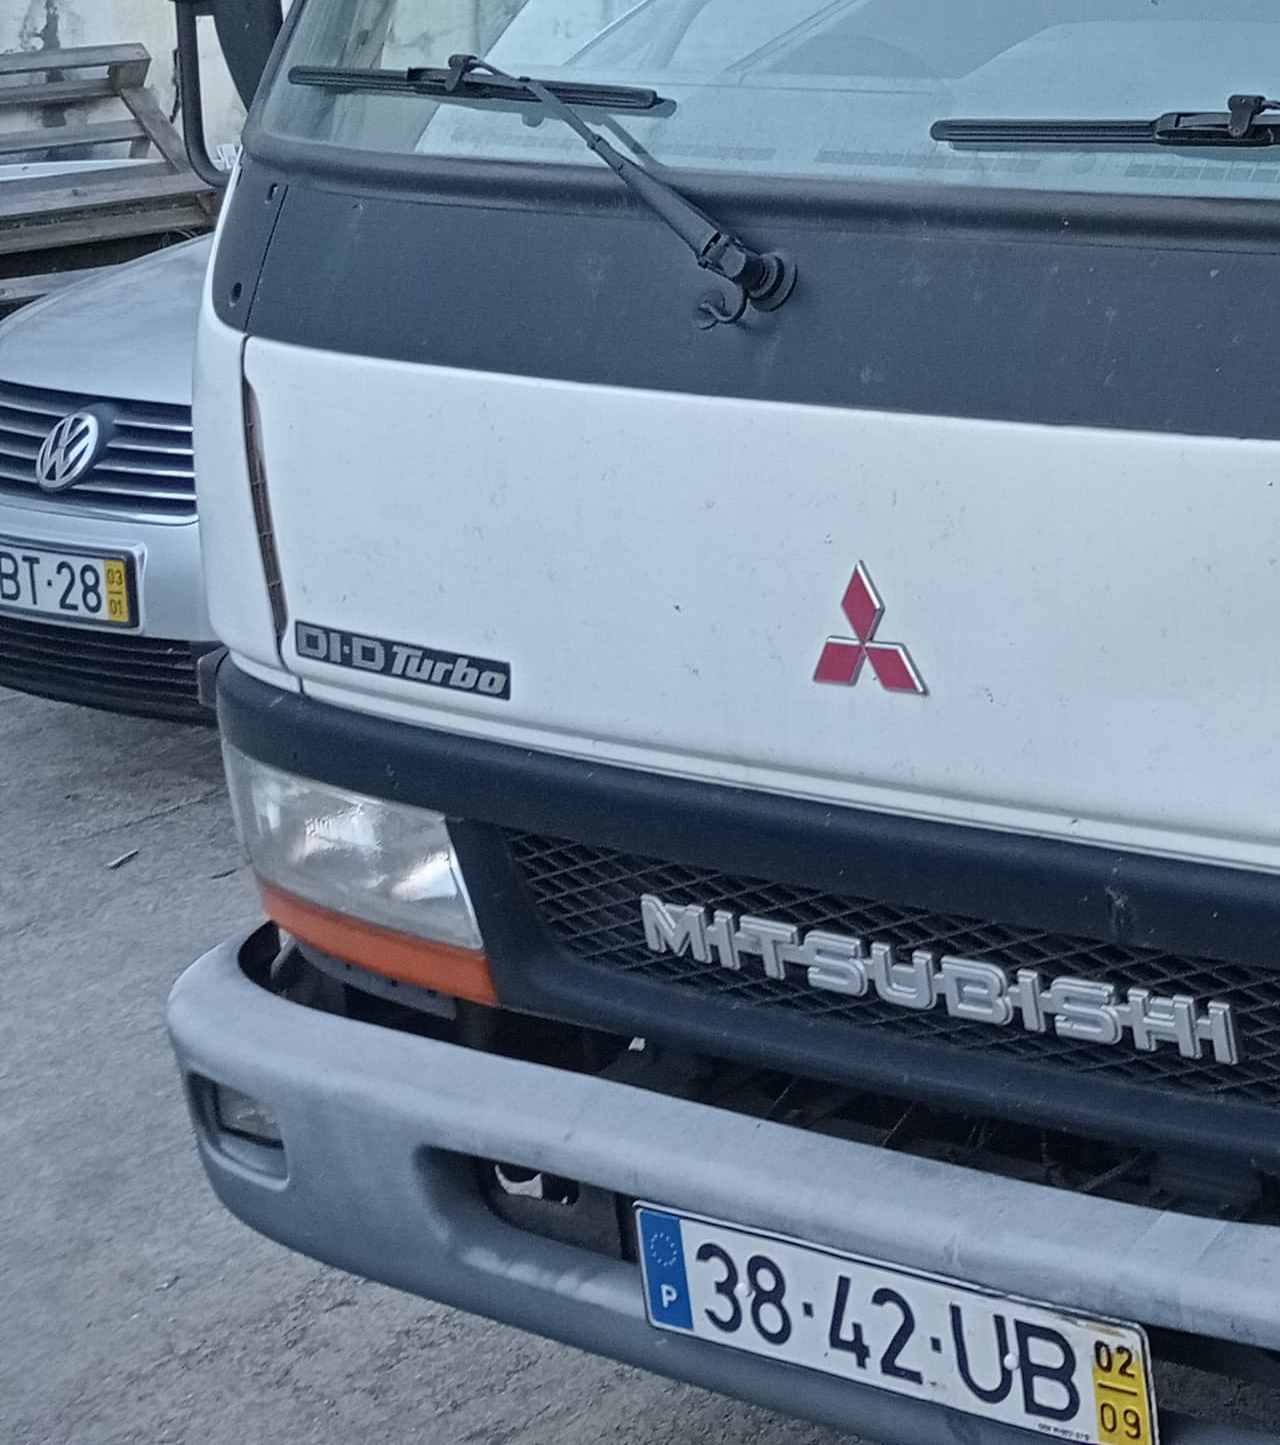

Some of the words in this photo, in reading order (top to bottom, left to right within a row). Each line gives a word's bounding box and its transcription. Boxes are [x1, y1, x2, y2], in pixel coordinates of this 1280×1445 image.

[296, 623, 386, 671] DI-D
[391, 644, 508, 695] Turbo
[640, 893, 1239, 1066] MITSUBISHI
[661, 1283, 678, 1309] P
[1094, 1339, 1136, 1379] 02
[1100, 1401, 1142, 1440] 09
